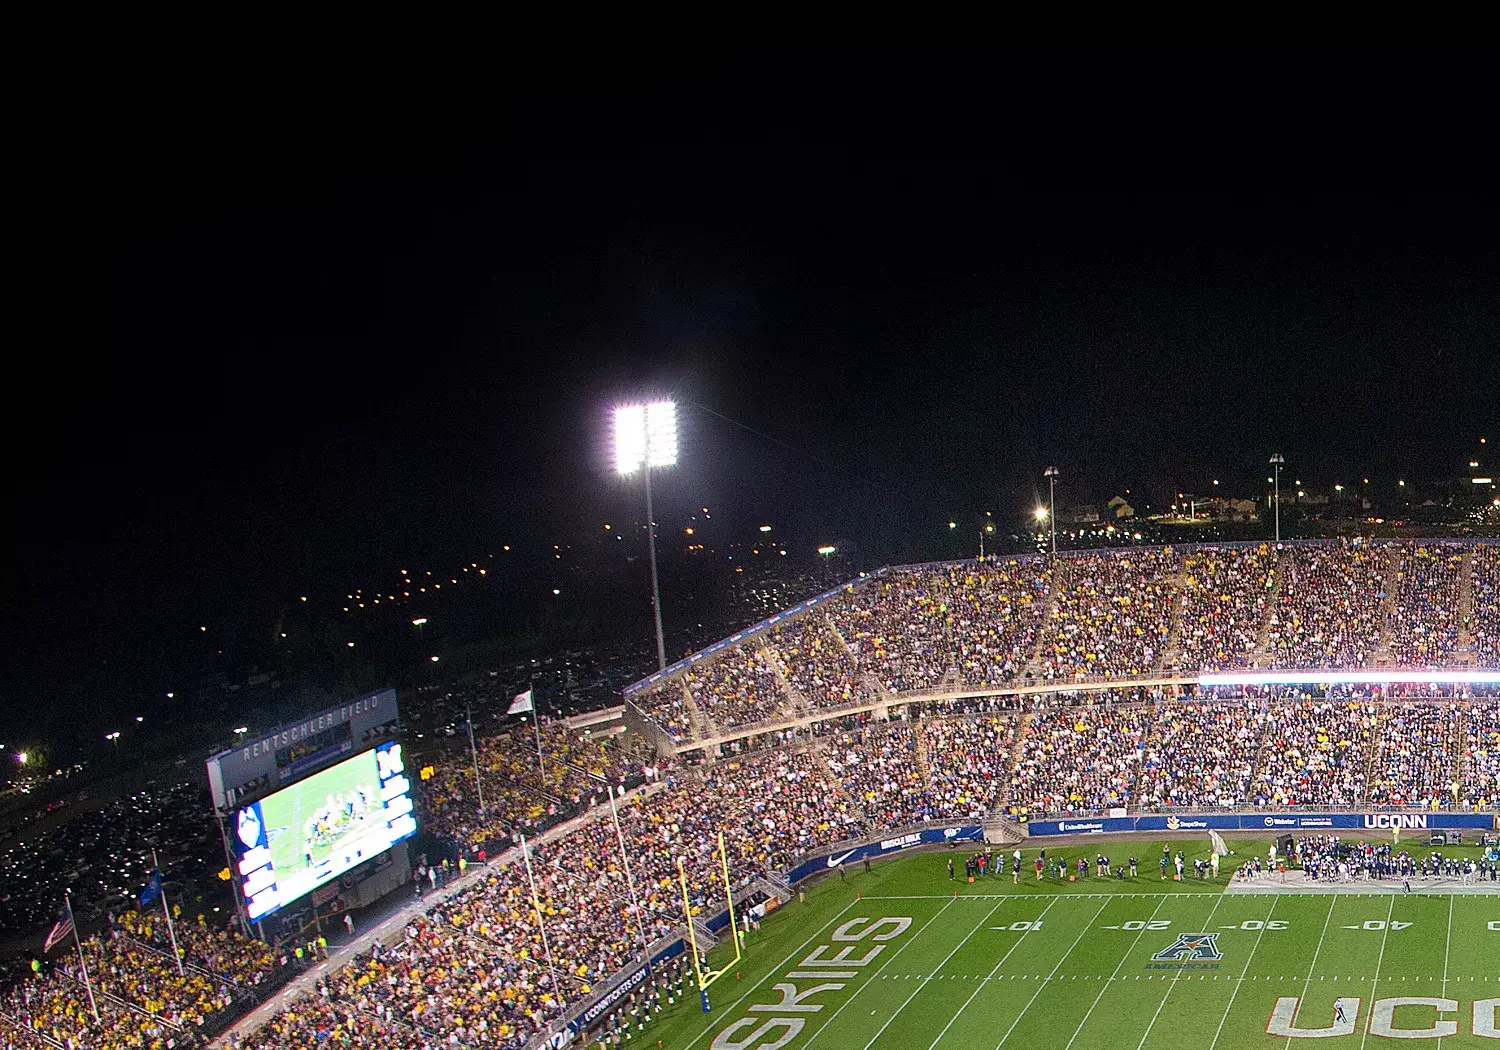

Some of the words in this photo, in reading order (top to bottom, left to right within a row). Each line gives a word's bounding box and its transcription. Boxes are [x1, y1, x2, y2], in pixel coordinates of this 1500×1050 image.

[243, 707, 333, 762] RENTSCHLER
[341, 696, 378, 721] FIELD
[1364, 814, 1427, 829] UCONN
[1009, 921, 1043, 931] 10
[1119, 920, 1171, 931] 20
[1240, 920, 1289, 931] 30
[1362, 920, 1413, 931] 40
